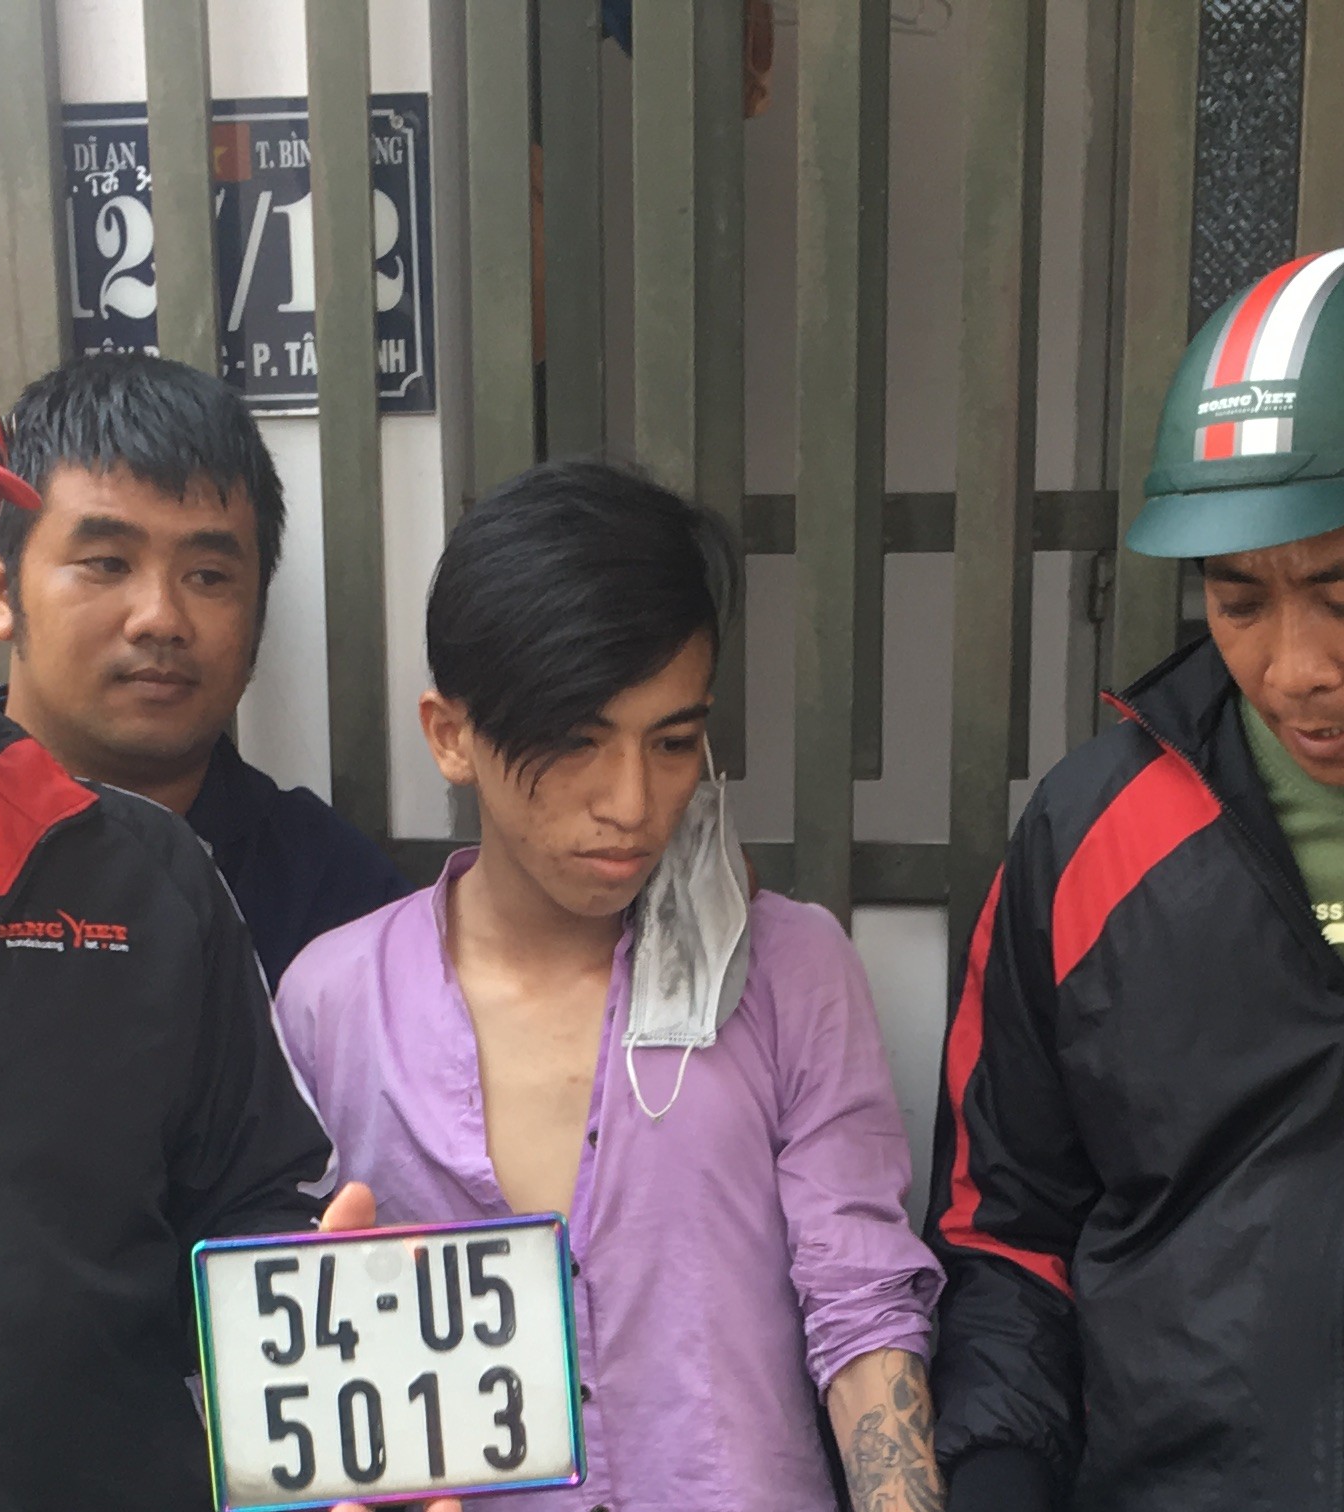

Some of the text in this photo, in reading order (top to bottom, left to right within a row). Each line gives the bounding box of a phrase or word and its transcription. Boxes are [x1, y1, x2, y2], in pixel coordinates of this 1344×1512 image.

[278, 130, 312, 168] BÌN
[1311, 902, 1344, 921] SS
[253, 1238, 517, 1366] 54-U5
[264, 1365, 528, 1491] 5013
